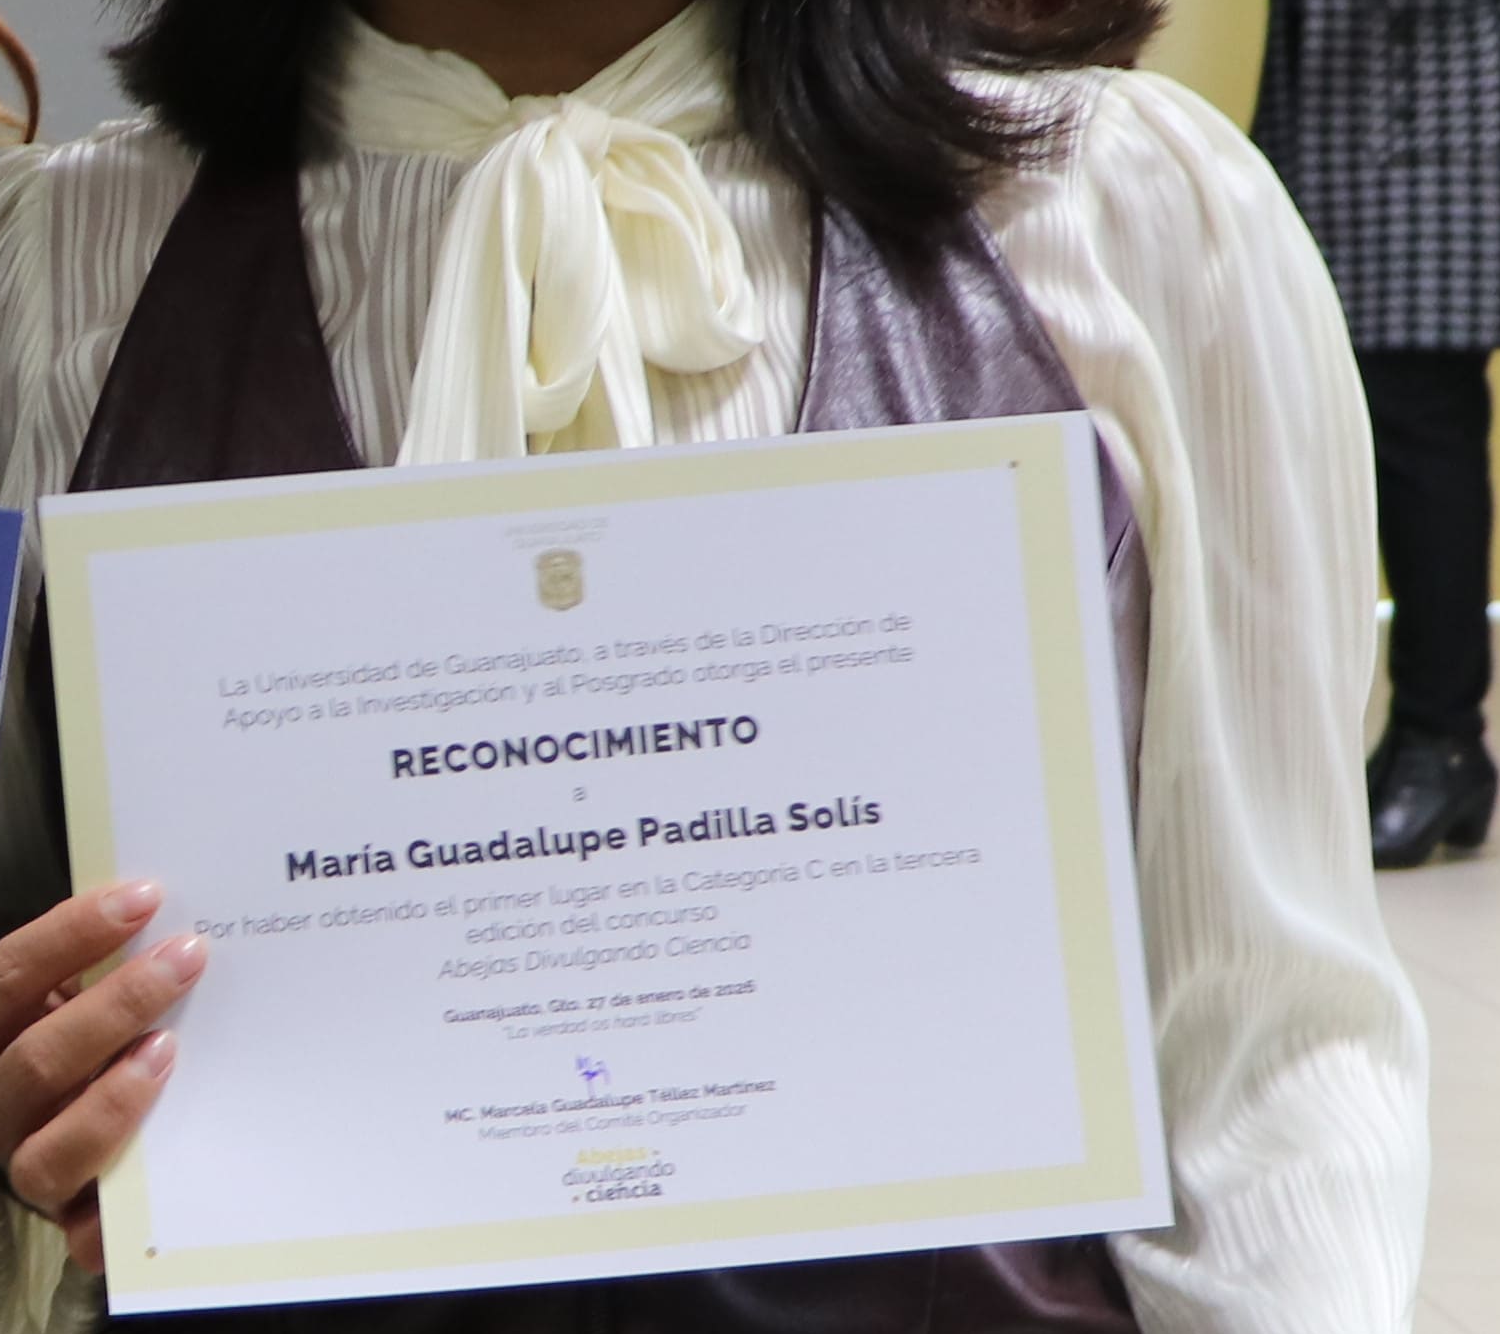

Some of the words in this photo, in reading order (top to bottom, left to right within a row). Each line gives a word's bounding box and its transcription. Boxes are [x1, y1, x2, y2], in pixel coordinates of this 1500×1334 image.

[218, 678, 250, 698] La
[254, 661, 400, 694] Universidad
[406, 659, 439, 679] de
[593, 645, 609, 661] a
[613, 635, 689, 659] través
[694, 632, 727, 651] de
[732, 628, 755, 647] la
[760, 618, 874, 645] Dirección
[879, 613, 912, 633] de
[223, 706, 303, 732] Apoyo
[308, 704, 324, 721] a
[328, 698, 352, 718] la
[357, 685, 516, 715] Investigación
[521, 683, 538, 705] y
[543, 677, 567, 697] al
[571, 667, 686, 695] Posgrado
[692, 660, 773, 683] otorga
[777, 655, 803, 674] el
[806, 645, 915, 676] presente
[392, 716, 758, 778] RECONOCIMIENTO
[573, 787, 587, 802] a
[286, 844, 396, 882] María
[406, 827, 627, 869] Guadalupe
[638, 807, 777, 847] Padilla
[788, 796, 881, 832] Solís
[242, 913, 312, 936] haber
[318, 900, 428, 928] obtenido
[433, 896, 458, 917] el
[463, 891, 543, 918] primer
[549, 885, 612, 909] lugar
[618, 881, 650, 898] en
[654, 876, 676, 895] la
[682, 863, 800, 892] Categoría
[804, 859, 825, 880] C
[829, 860, 862, 877] en
[866, 854, 890, 873] la
[893, 848, 981, 871] tercera
[465, 921, 554, 944] edición
[560, 913, 599, 935] del
[605, 905, 719, 931] concurso
[437, 955, 519, 981] Abejas
[524, 940, 660, 971] Divulgando
[665, 931, 752, 957] Ciencia
[551, 1094, 644, 1112] Guadalupe
[562, 1160, 676, 1186] divulgando
[586, 1180, 663, 1203] ciencia
